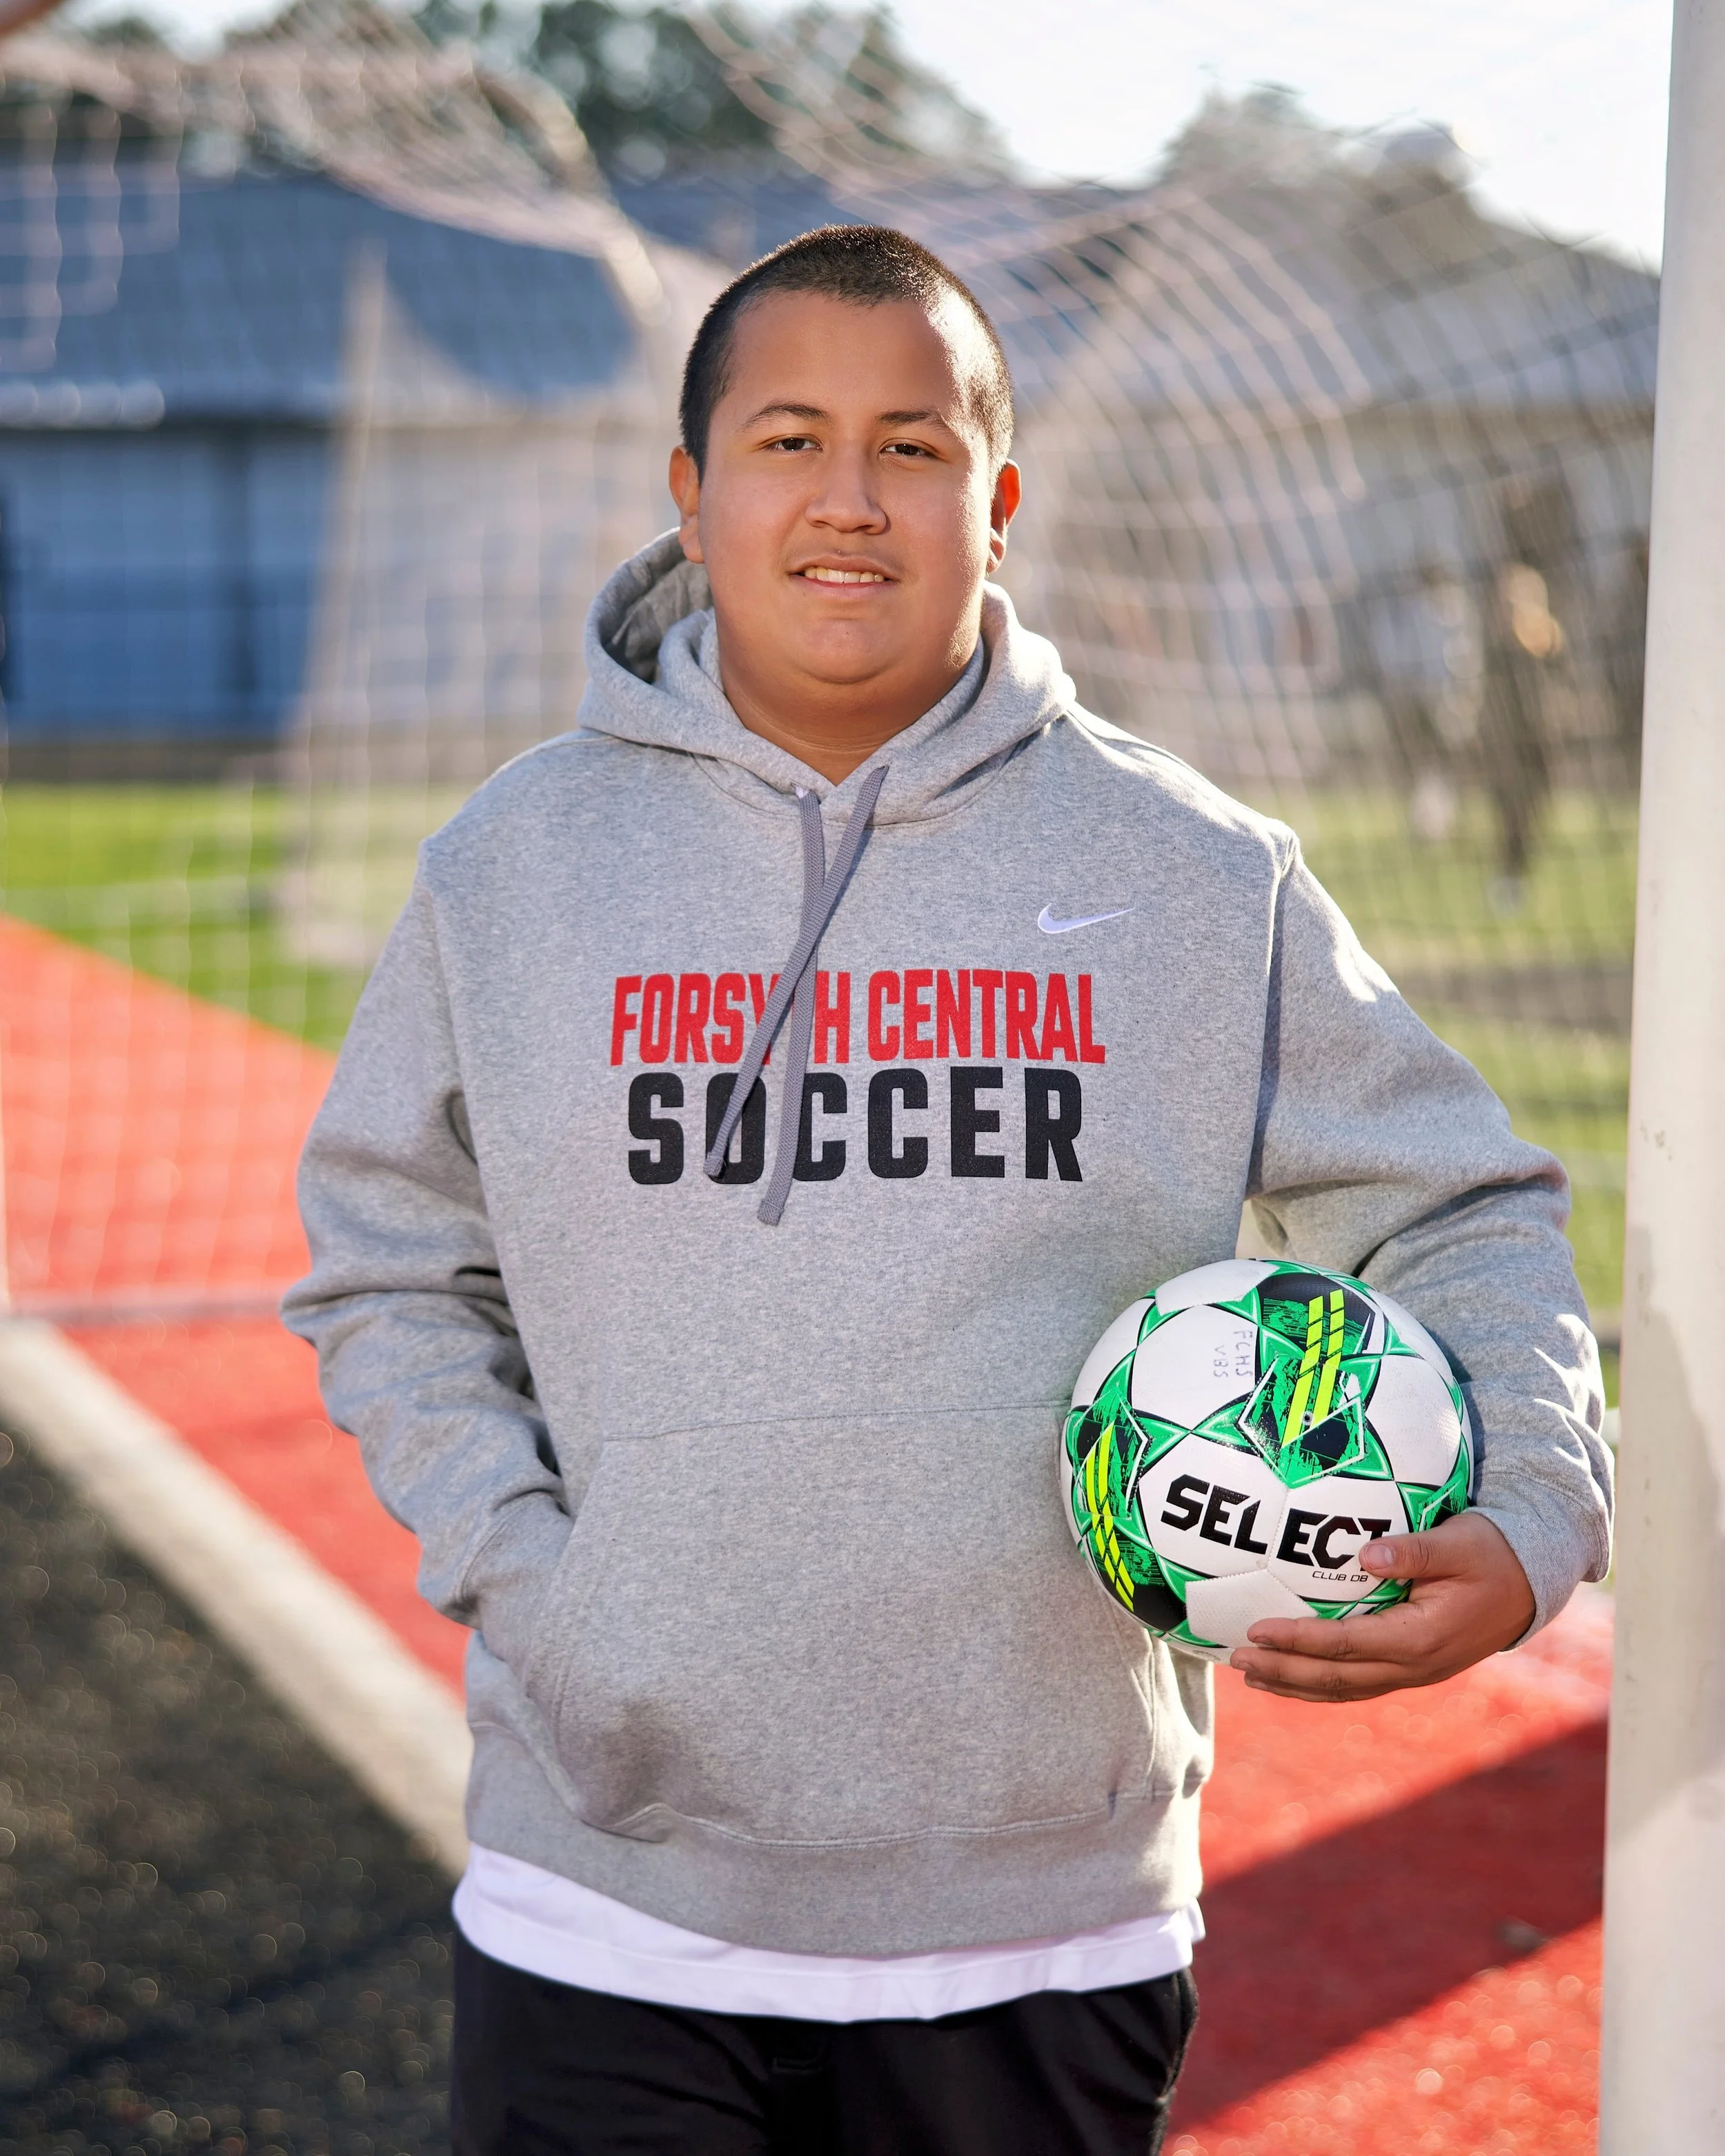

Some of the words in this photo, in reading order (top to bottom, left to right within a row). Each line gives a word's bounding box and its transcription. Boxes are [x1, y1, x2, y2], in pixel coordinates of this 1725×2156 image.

[610, 971, 851, 1066] FORSYH
[867, 969, 1106, 1064] CENTRAL
[628, 1067, 1083, 1185] SOCCER
[1233, 1330, 1254, 1376] FCHS
[1312, 1570, 1347, 1581] CLUB
